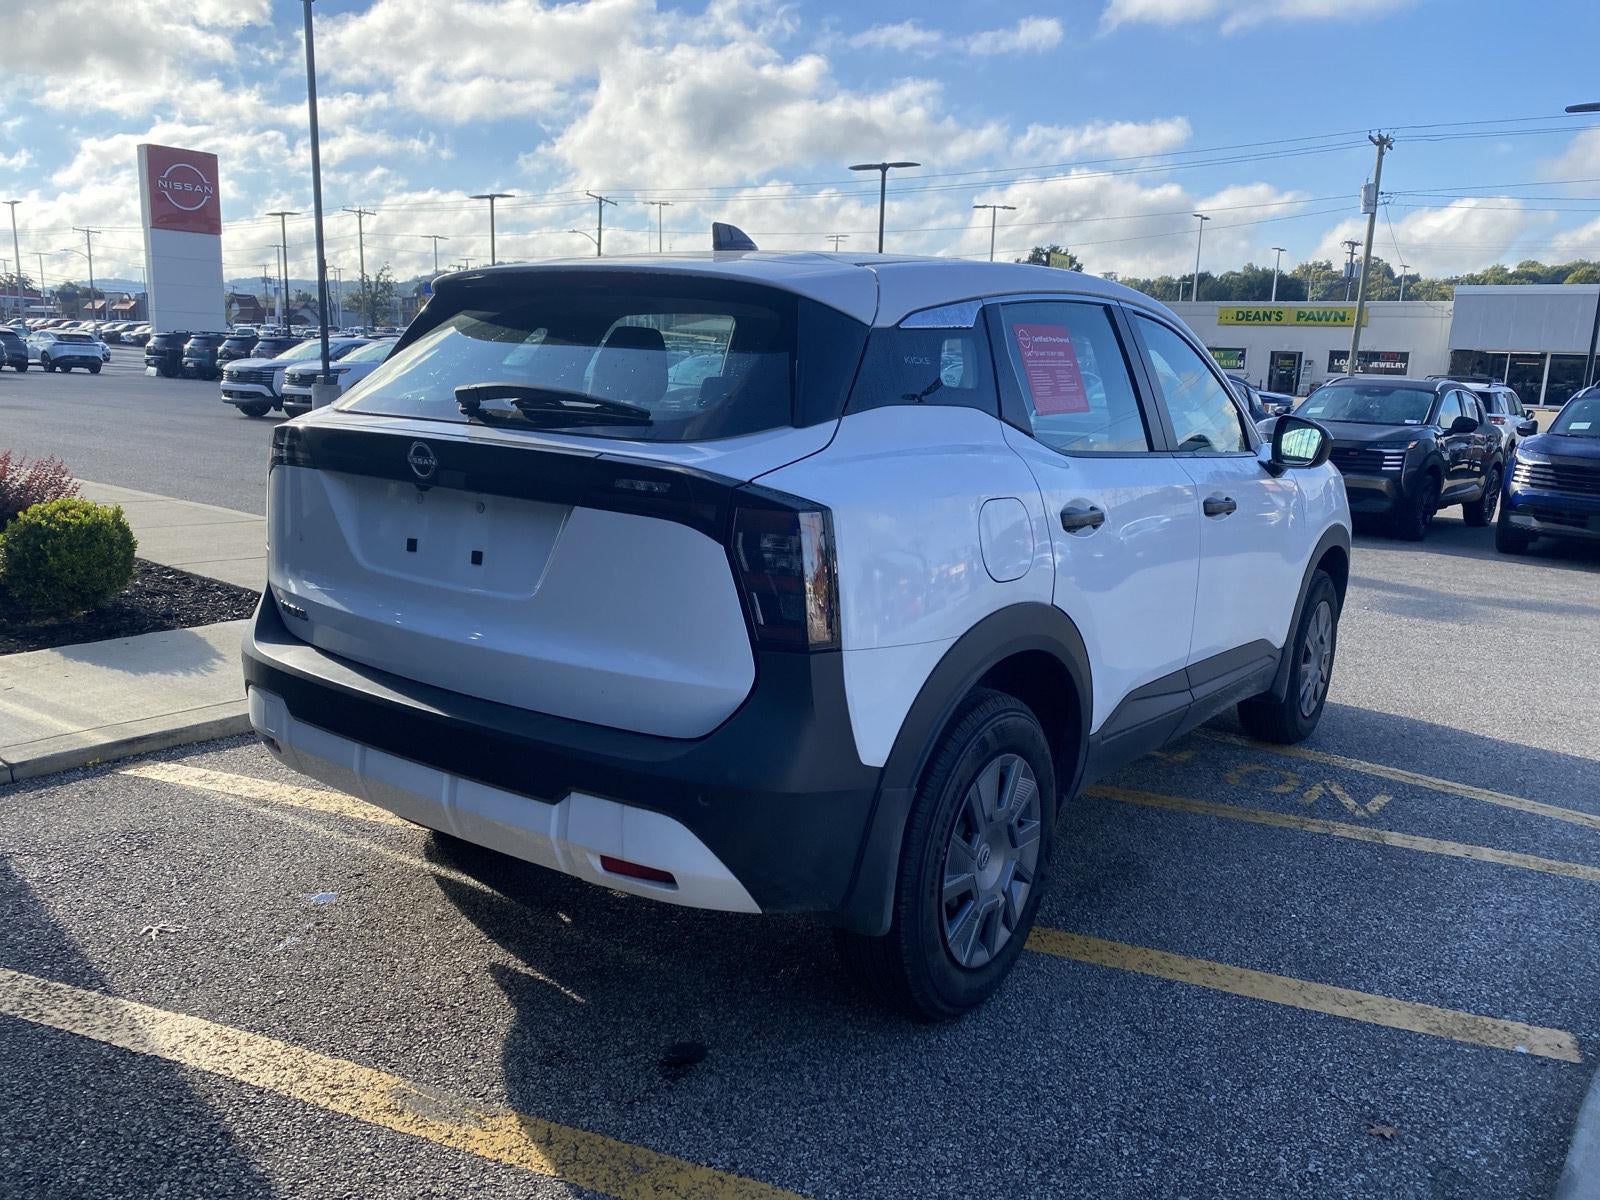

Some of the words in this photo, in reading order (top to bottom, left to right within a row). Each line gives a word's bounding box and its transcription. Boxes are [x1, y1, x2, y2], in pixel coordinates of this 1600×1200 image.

[157, 179, 213, 194] NISSAN
[1296, 310, 1346, 322] PAWN
[1369, 361, 1407, 369] JEWELRY
